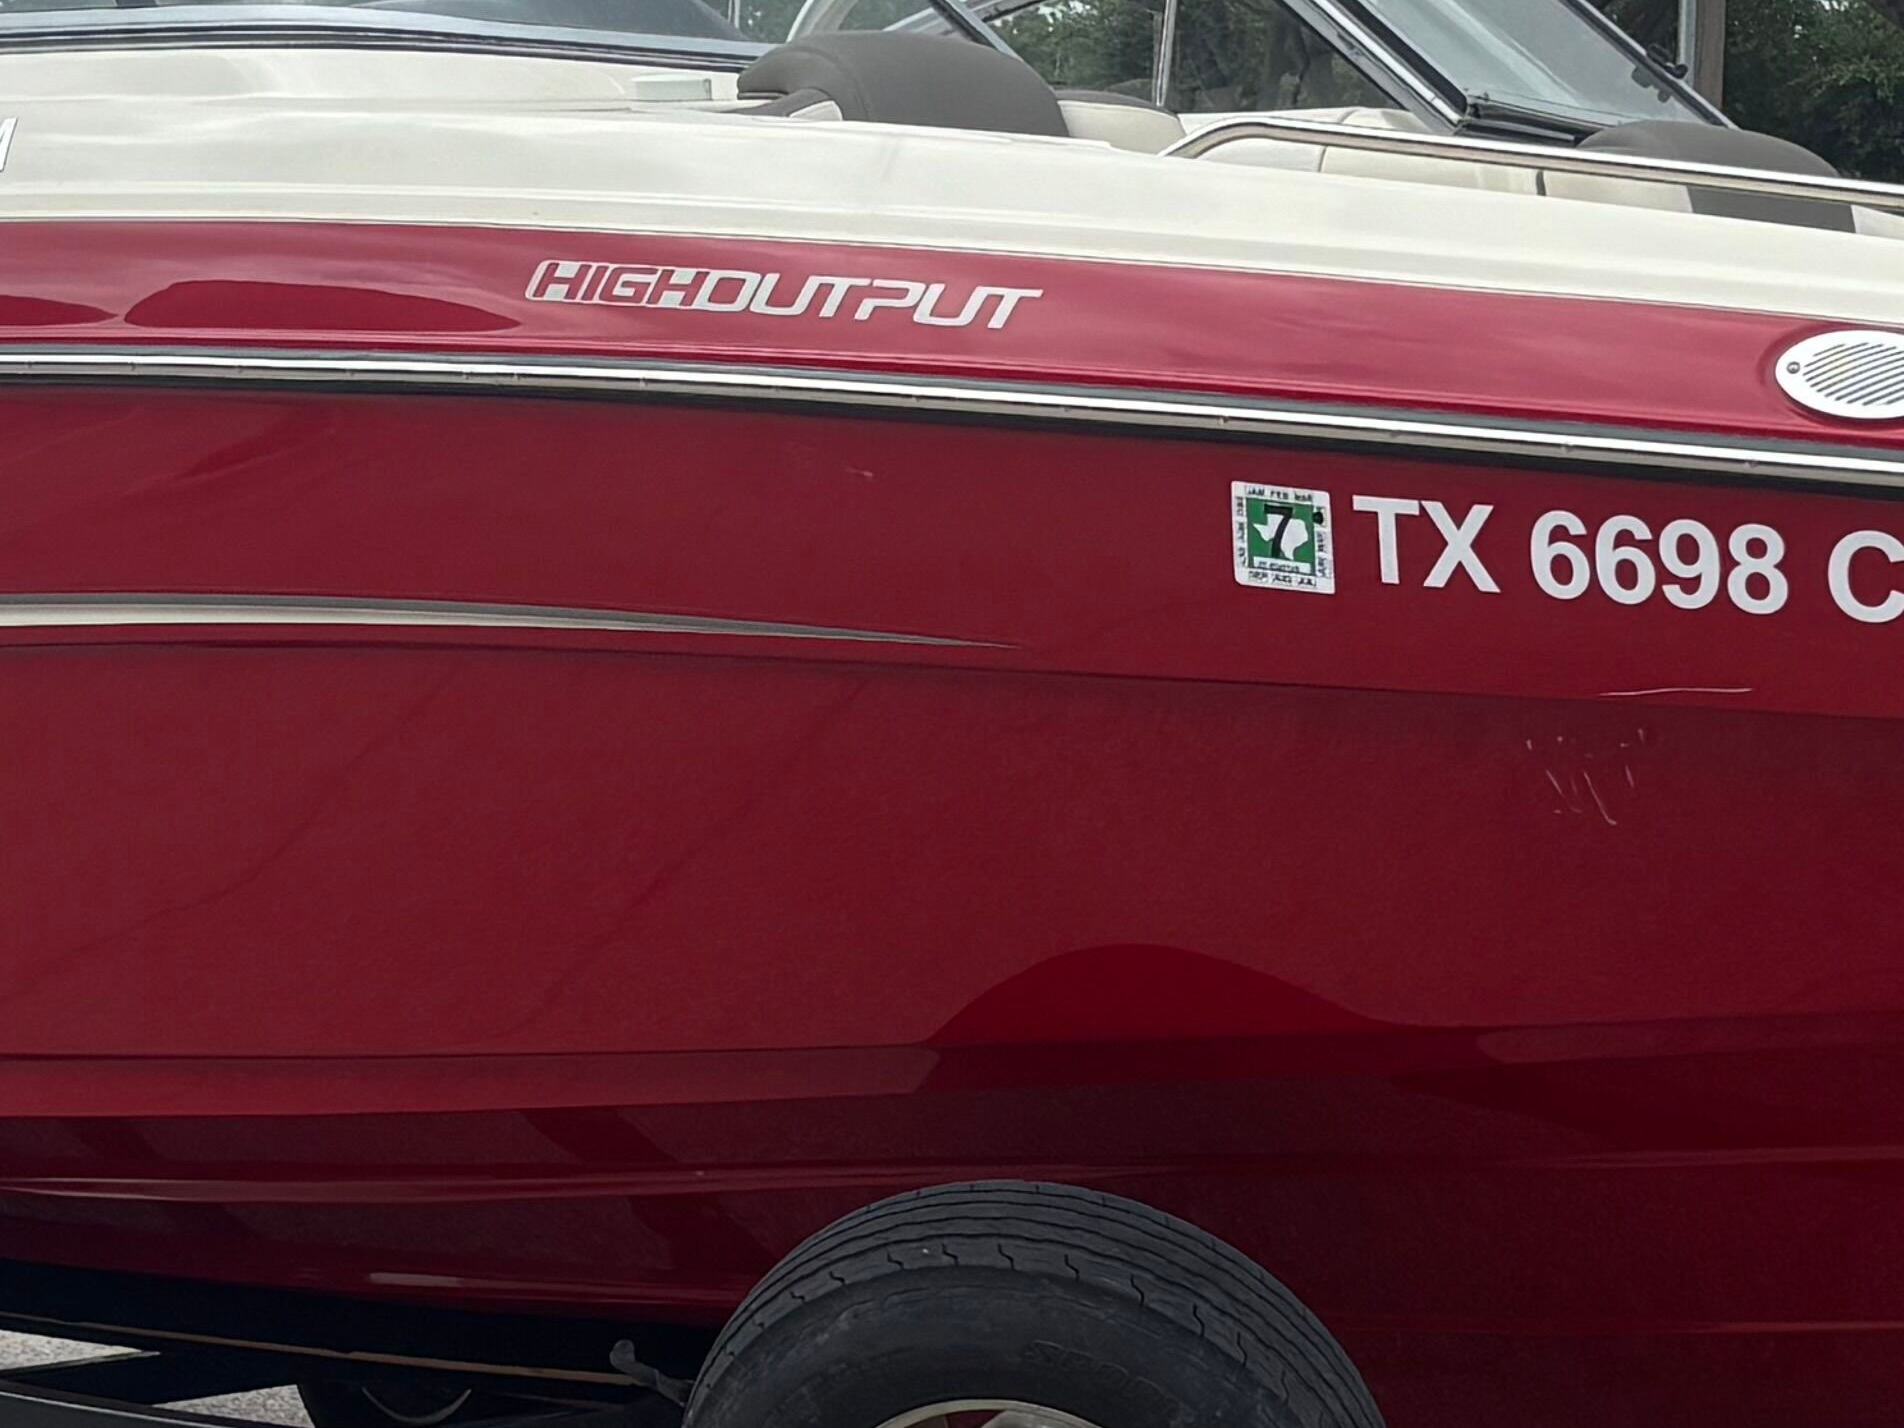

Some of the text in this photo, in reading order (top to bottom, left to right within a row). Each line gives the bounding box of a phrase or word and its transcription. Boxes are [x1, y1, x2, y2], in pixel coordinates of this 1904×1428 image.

[1263, 503, 1294, 559] 7
[1352, 494, 1501, 594] TX
[1530, 509, 1789, 616] 6698
